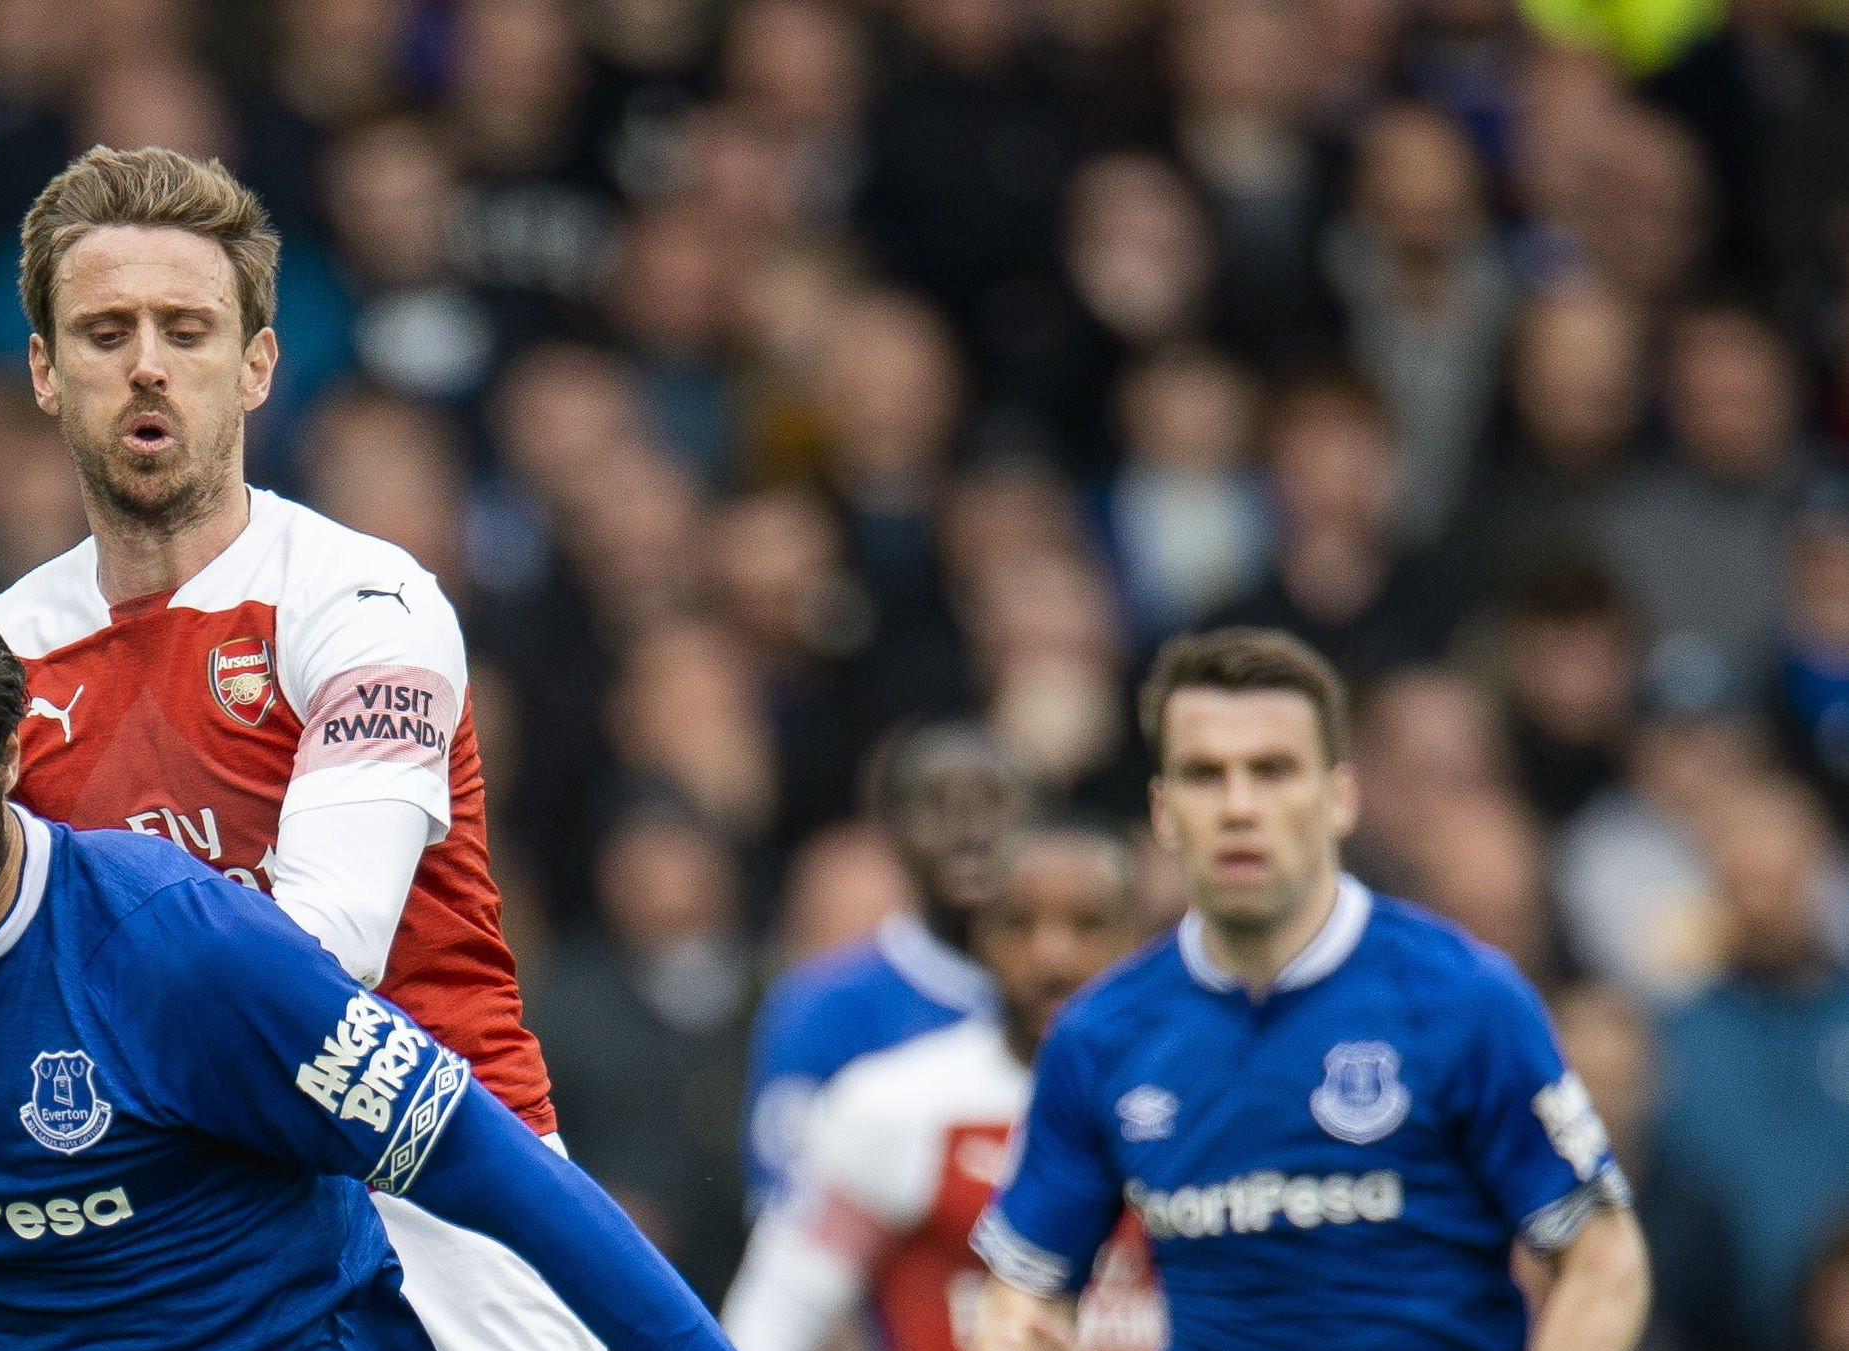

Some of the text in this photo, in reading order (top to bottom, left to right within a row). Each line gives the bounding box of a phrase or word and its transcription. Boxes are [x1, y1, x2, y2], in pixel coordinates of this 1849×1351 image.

[356, 684, 433, 718] VISIT
[322, 714, 447, 760] RWANDA
[125, 807, 223, 861] Fly
[295, 990, 392, 1114] ANGRY
[339, 1014, 428, 1133] BIRDS
[41, 1107, 89, 1122] Everton
